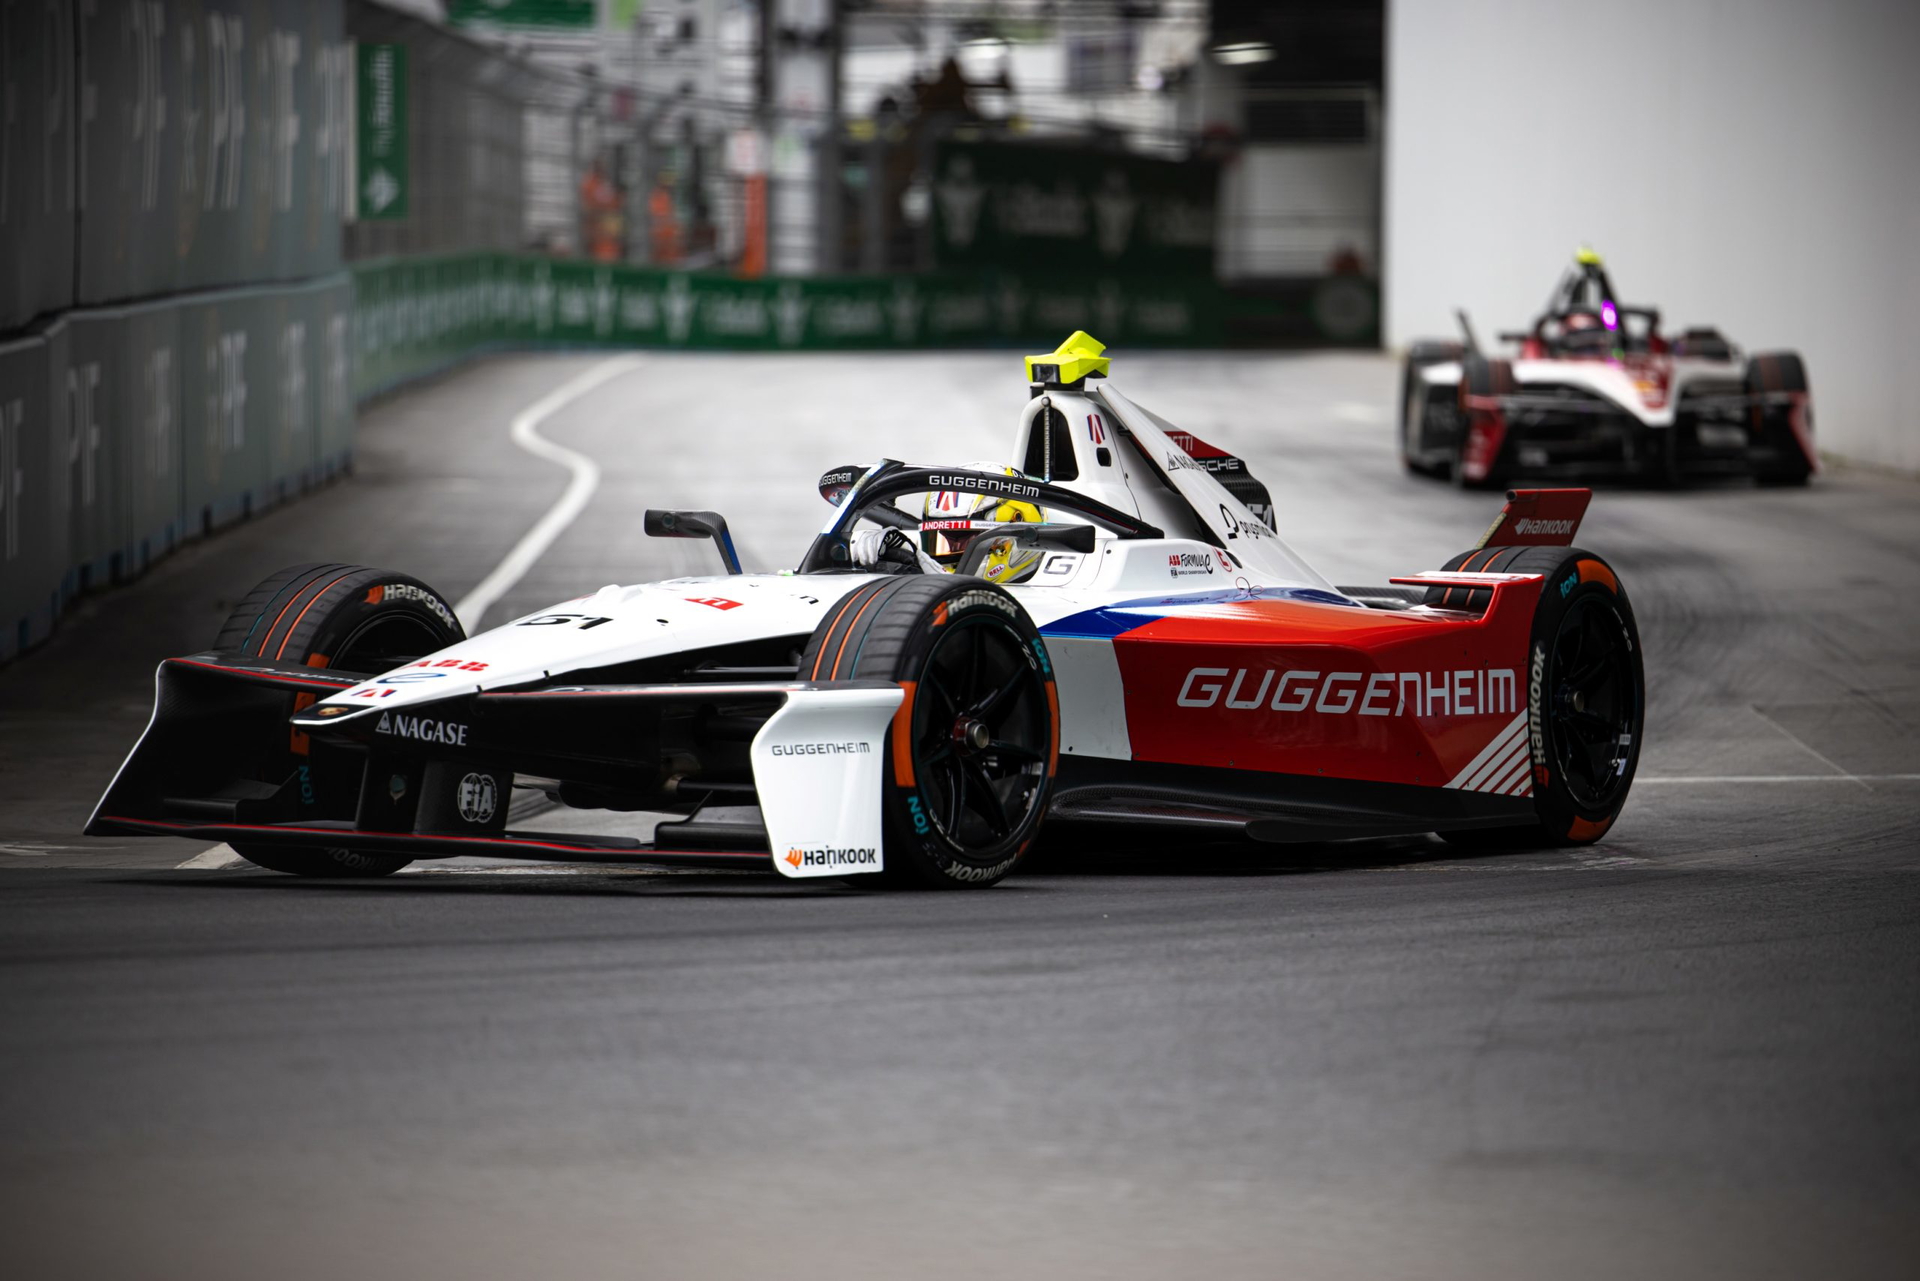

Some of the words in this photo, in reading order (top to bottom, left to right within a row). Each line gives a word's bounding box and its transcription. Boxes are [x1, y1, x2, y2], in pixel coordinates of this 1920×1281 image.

[929, 475, 1040, 498] GUGGENHEIM
[923, 520, 967, 531] ANDRETTI
[987, 565, 1005, 577] BELL
[1043, 555, 1077, 576] G
[1176, 667, 1516, 717] GUGGENHEIM
[393, 713, 469, 746] NAGASE
[772, 742, 871, 757] GUGGENHEIM
